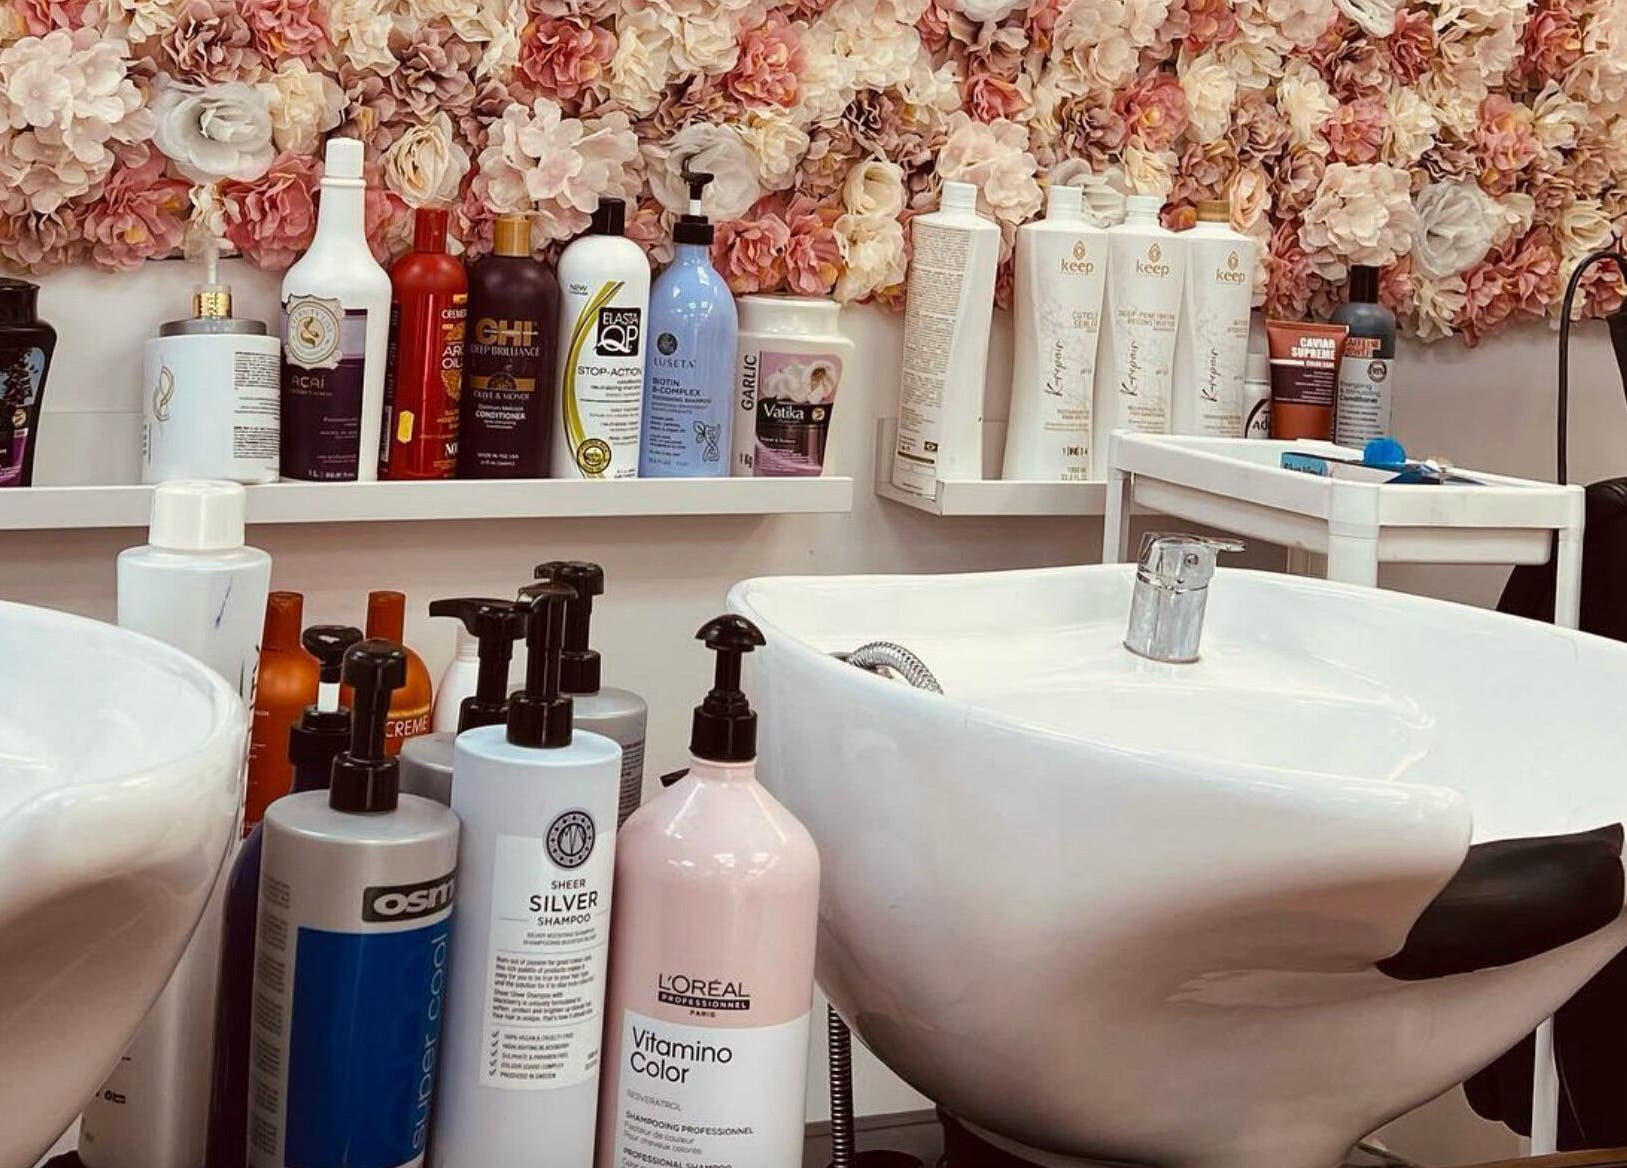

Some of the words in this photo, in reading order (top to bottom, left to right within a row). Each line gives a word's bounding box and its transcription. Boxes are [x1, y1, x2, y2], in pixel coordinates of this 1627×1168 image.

[1060, 258, 1094, 275] keep
[1136, 259, 1170, 277] keep
[1216, 268, 1246, 285] keep
[603, 312, 638, 325] ELASTA
[475, 318, 533, 347] CHI
[597, 325, 638, 353] QP
[1300, 337, 1335, 348] CAVIAR
[442, 346, 463, 357] AR
[492, 346, 540, 357] BRILLIANCE
[1291, 347, 1335, 360] SUPREME
[653, 357, 695, 368] LUSETA
[652, 377, 680, 387] BIOTIN
[741, 355, 757, 411] GARLIC
[652, 386, 701, 396] B-COMPLEX
[475, 410, 527, 420] CONDITIONER
[764, 403, 805, 420] Vatika
[385, 715, 429, 738] CREME
[551, 879, 587, 890] SHEER
[529, 891, 599, 912] SILVER
[537, 913, 591, 926] SHAMPOO
[658, 973, 751, 998] L'ORÉAL
[660, 993, 748, 1009] PROFESSIONNEL
[690, 1009, 716, 1018] PARIS
[412, 1033, 437, 1151] super
[428, 932, 448, 1022] cool
[632, 1025, 733, 1063] Vitamino
[630, 1051, 689, 1083] Color
[626, 1110, 679, 1132] SHAMPOOING
[681, 1125, 754, 1136] PROFESSIONNEL
[623, 1147, 684, 1168] PROFESSIONAL
